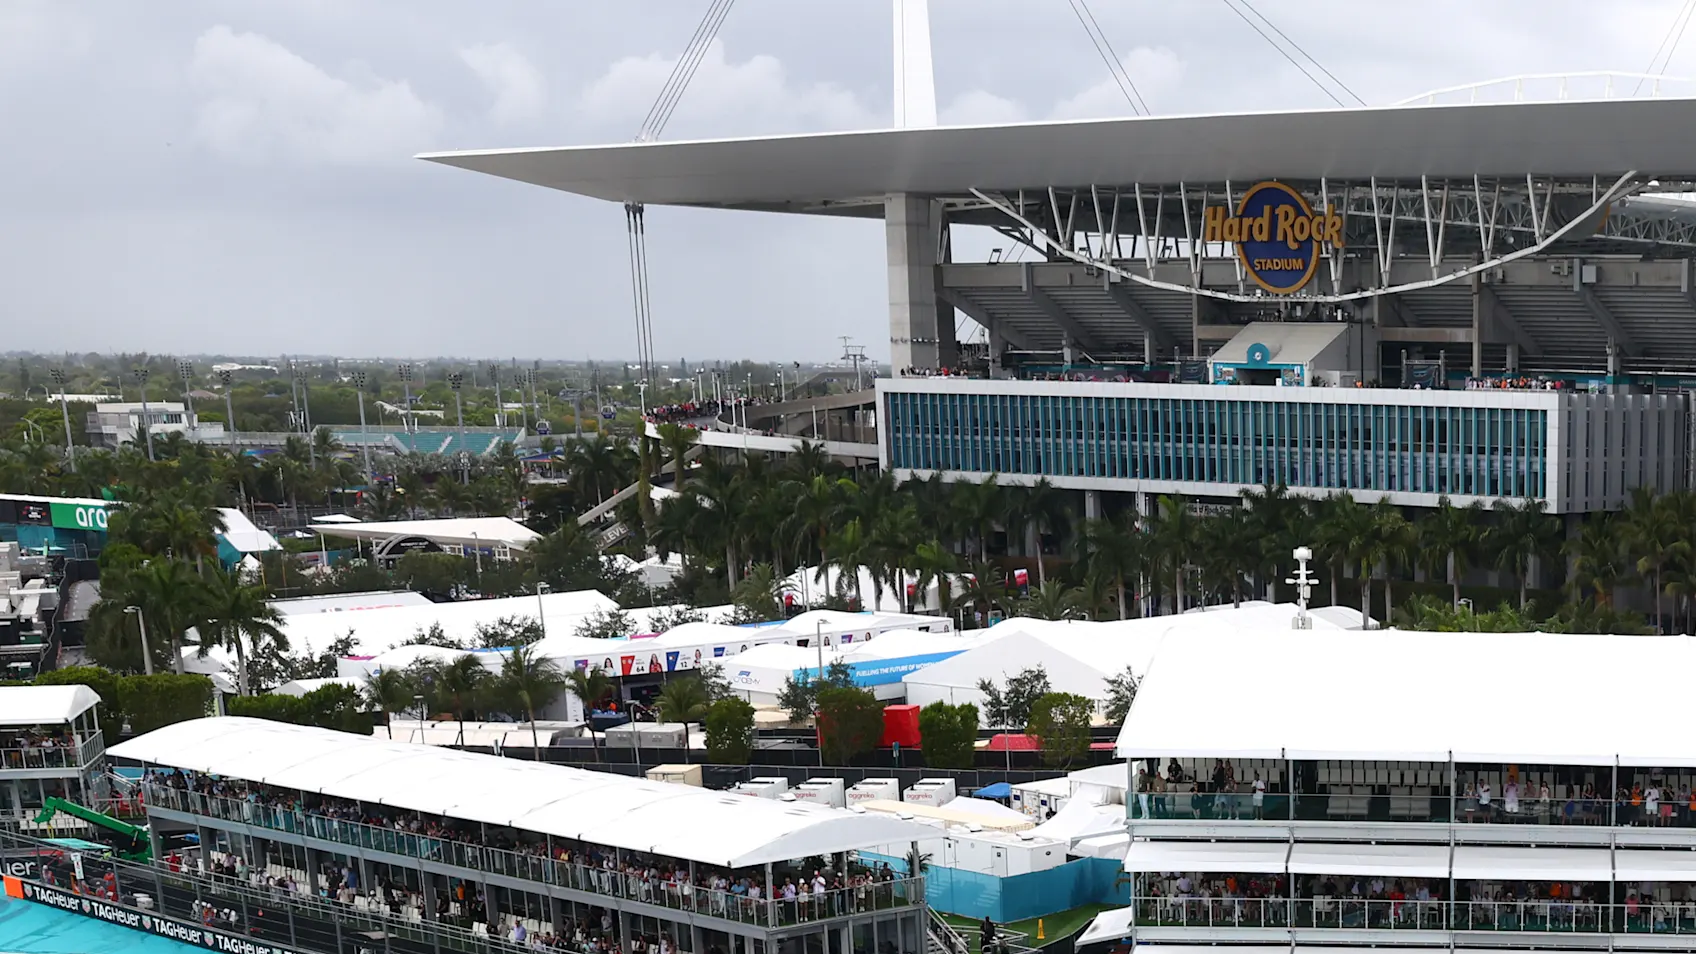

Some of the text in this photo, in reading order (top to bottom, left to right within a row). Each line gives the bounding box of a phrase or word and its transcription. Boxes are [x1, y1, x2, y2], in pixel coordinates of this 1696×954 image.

[1205, 204, 1346, 250] Hard Rock
[1254, 258, 1304, 271] STADIUM
[890, 665, 908, 673] FUTURE
[34, 887, 80, 911] TAGHeuer
[91, 902, 140, 926] TAGHeuer
[153, 917, 201, 943] TAGHeuer
